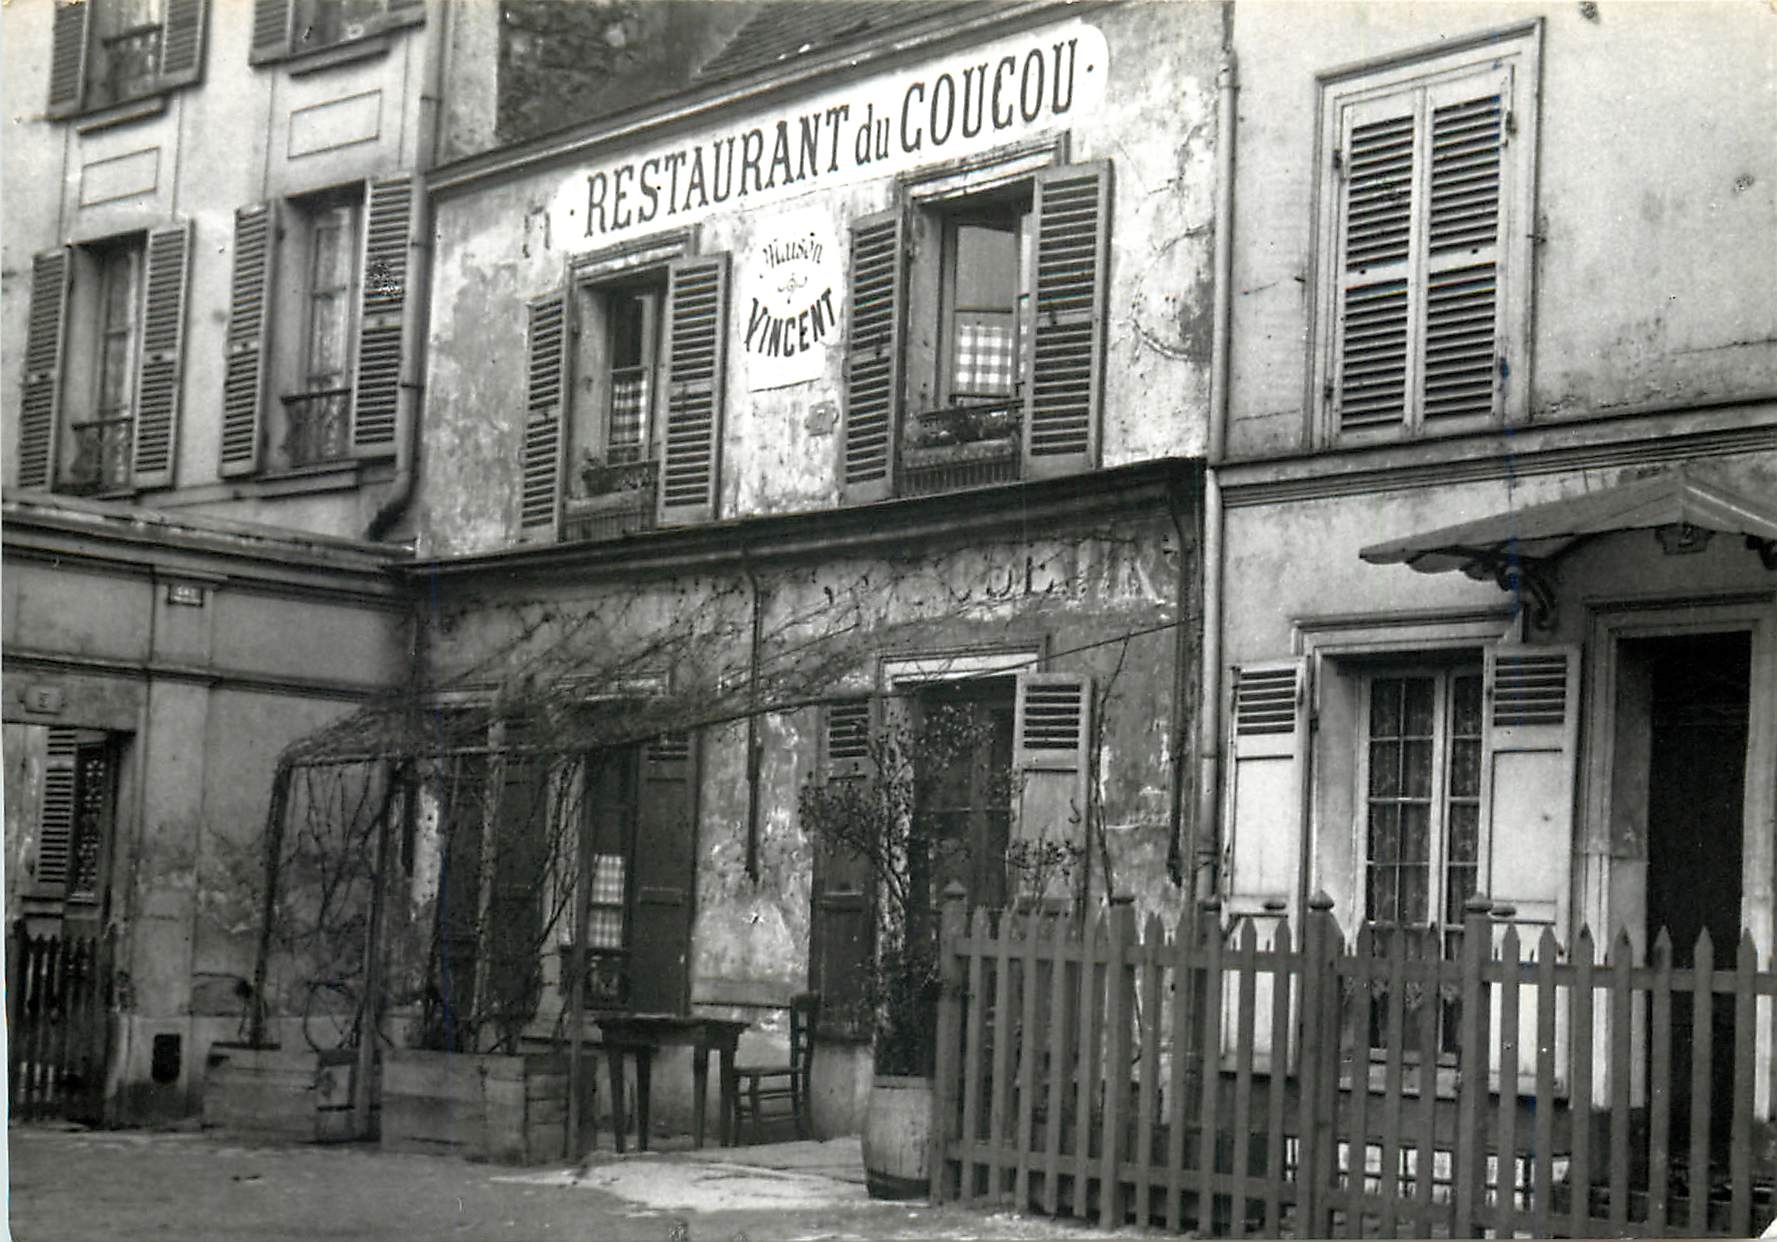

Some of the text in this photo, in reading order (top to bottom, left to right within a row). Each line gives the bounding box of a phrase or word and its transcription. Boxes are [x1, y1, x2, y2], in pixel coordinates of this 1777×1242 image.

[584, 104, 849, 238] RESTAURANT
[855, 103, 890, 166] du
[900, 38, 1078, 153] COUCOU
[744, 287, 836, 358] VINCENT
